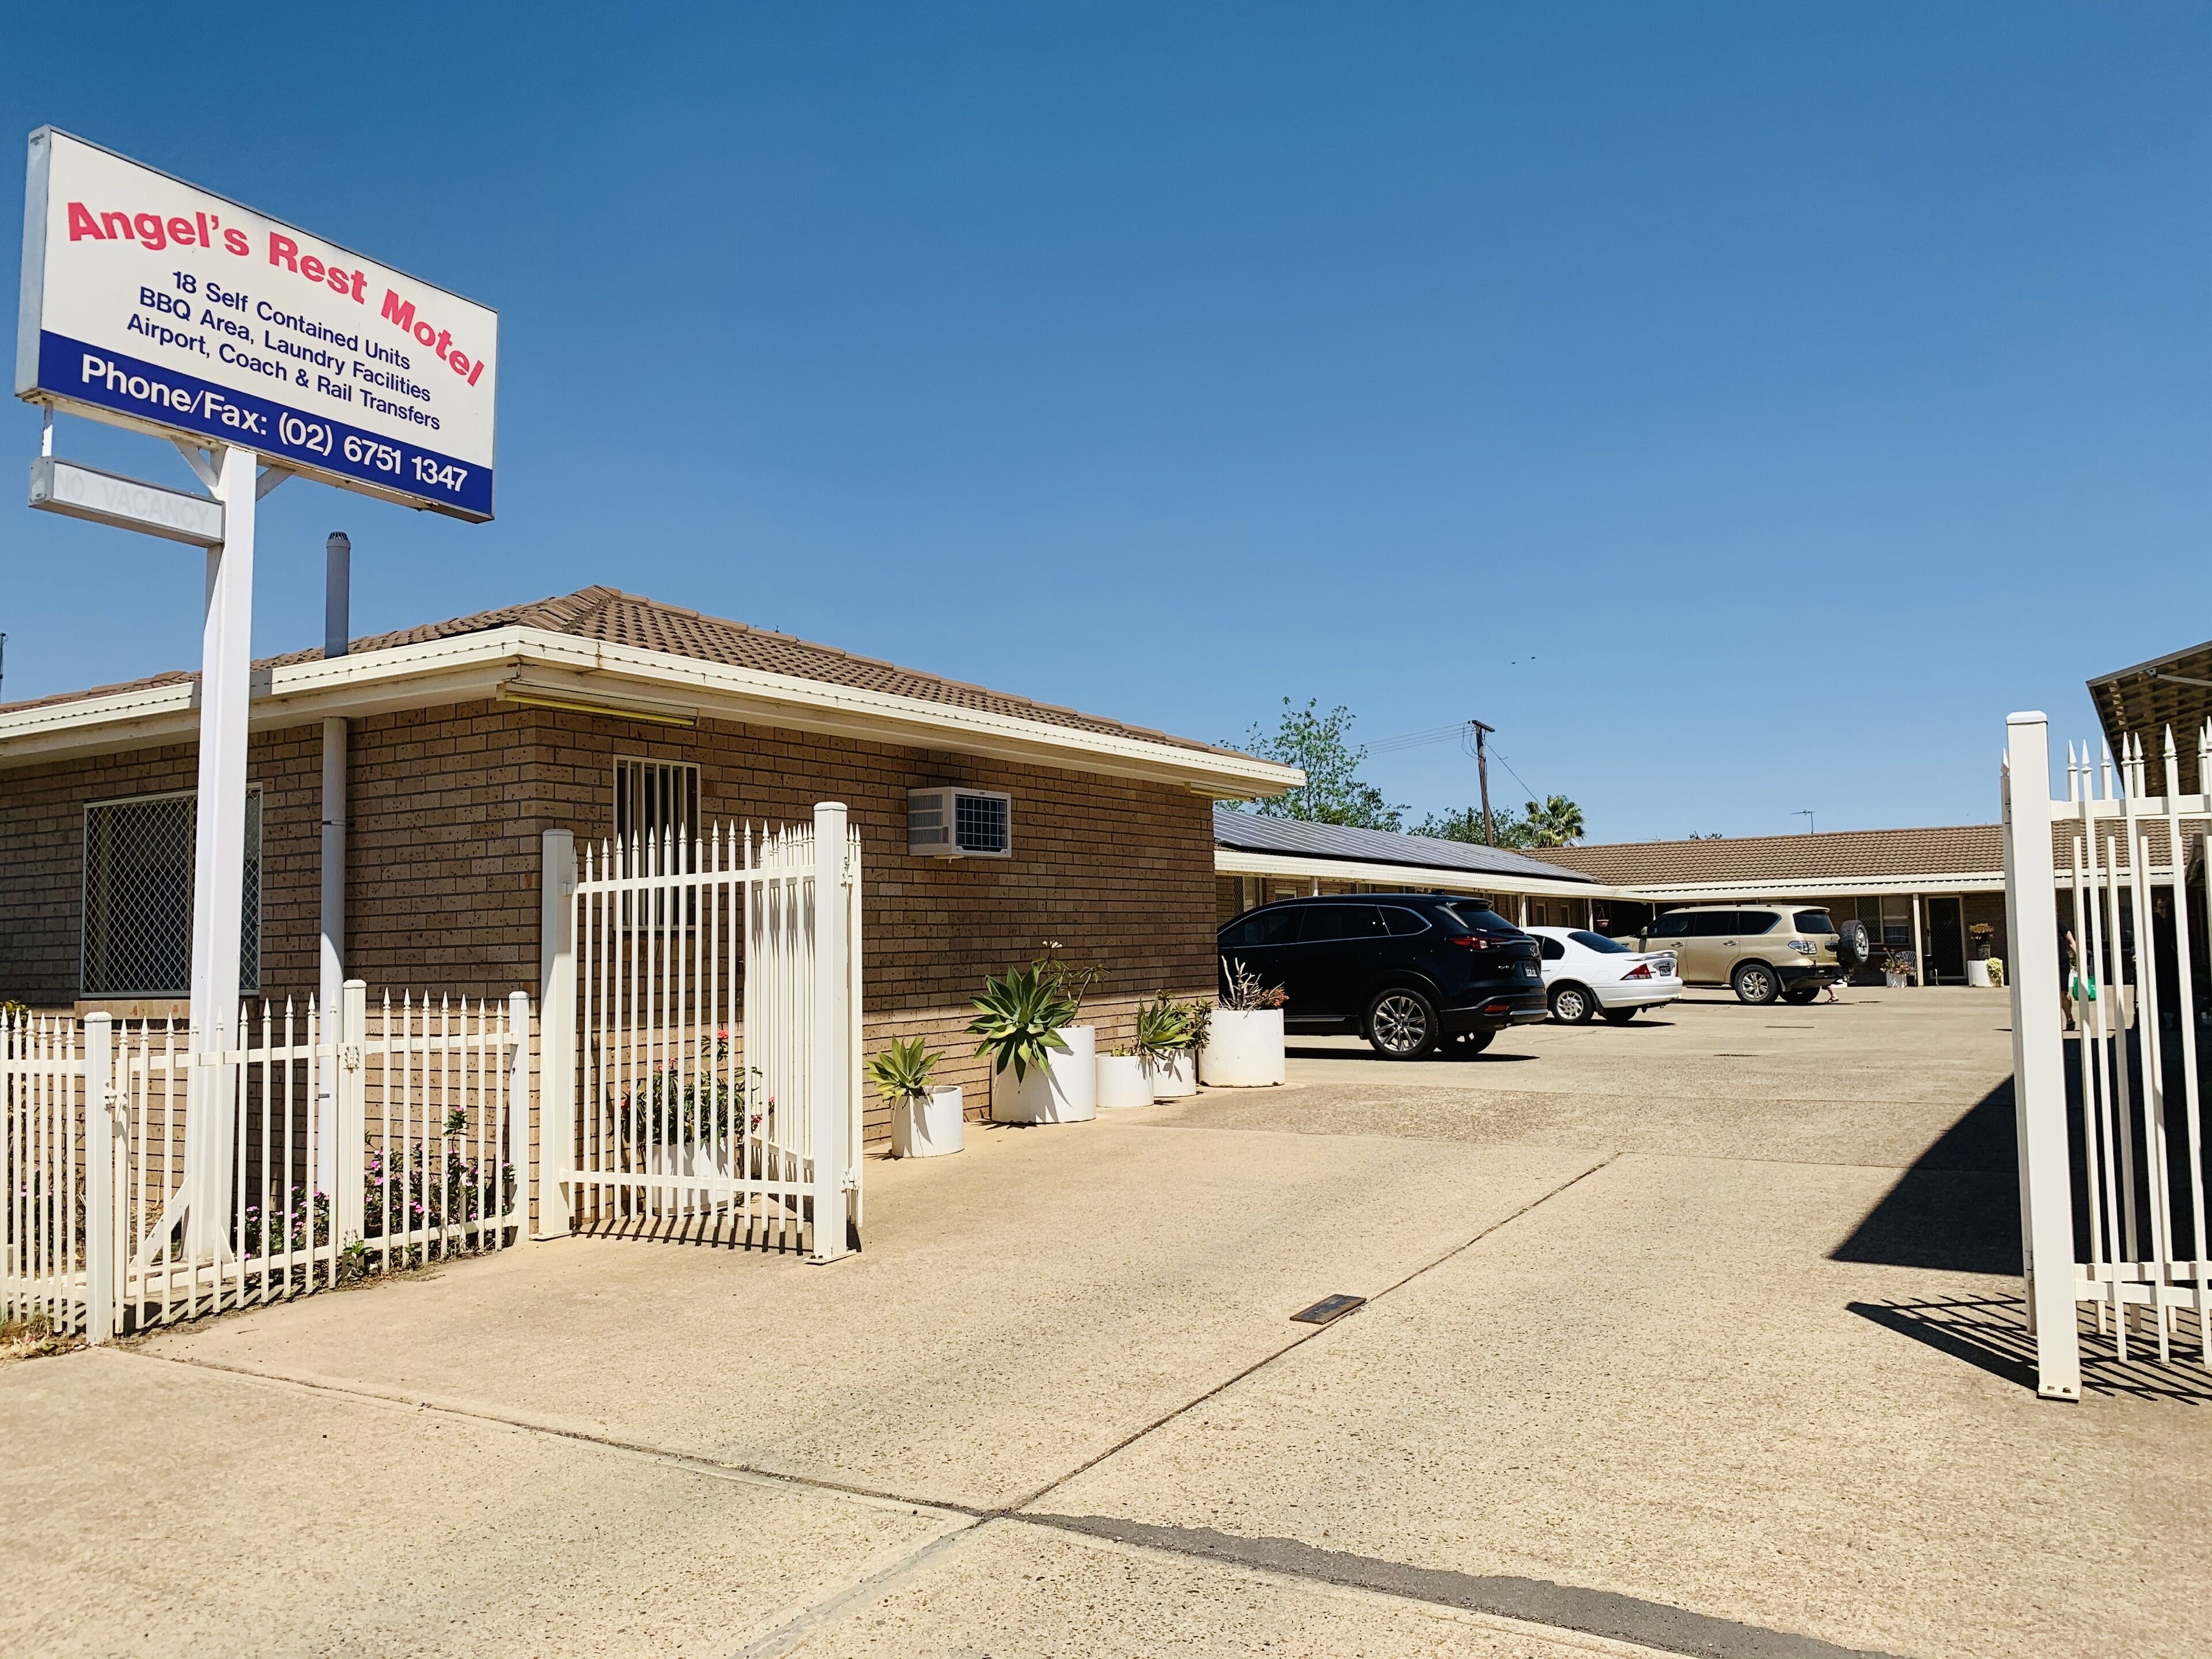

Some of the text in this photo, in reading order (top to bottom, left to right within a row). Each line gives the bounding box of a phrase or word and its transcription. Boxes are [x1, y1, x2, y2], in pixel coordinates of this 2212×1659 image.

[67, 202, 484, 388] Angel's Rest Motel
[140, 286, 431, 403] BBQ Area, Laundry Facilities
[173, 271, 411, 370] 18 Self Contained Units
[82, 353, 468, 492] Phone/Fax: (02) 6751 1347
[127, 313, 440, 430] Airport, Coach & Rail Transfers
[102, 480, 210, 528] VACANCY
